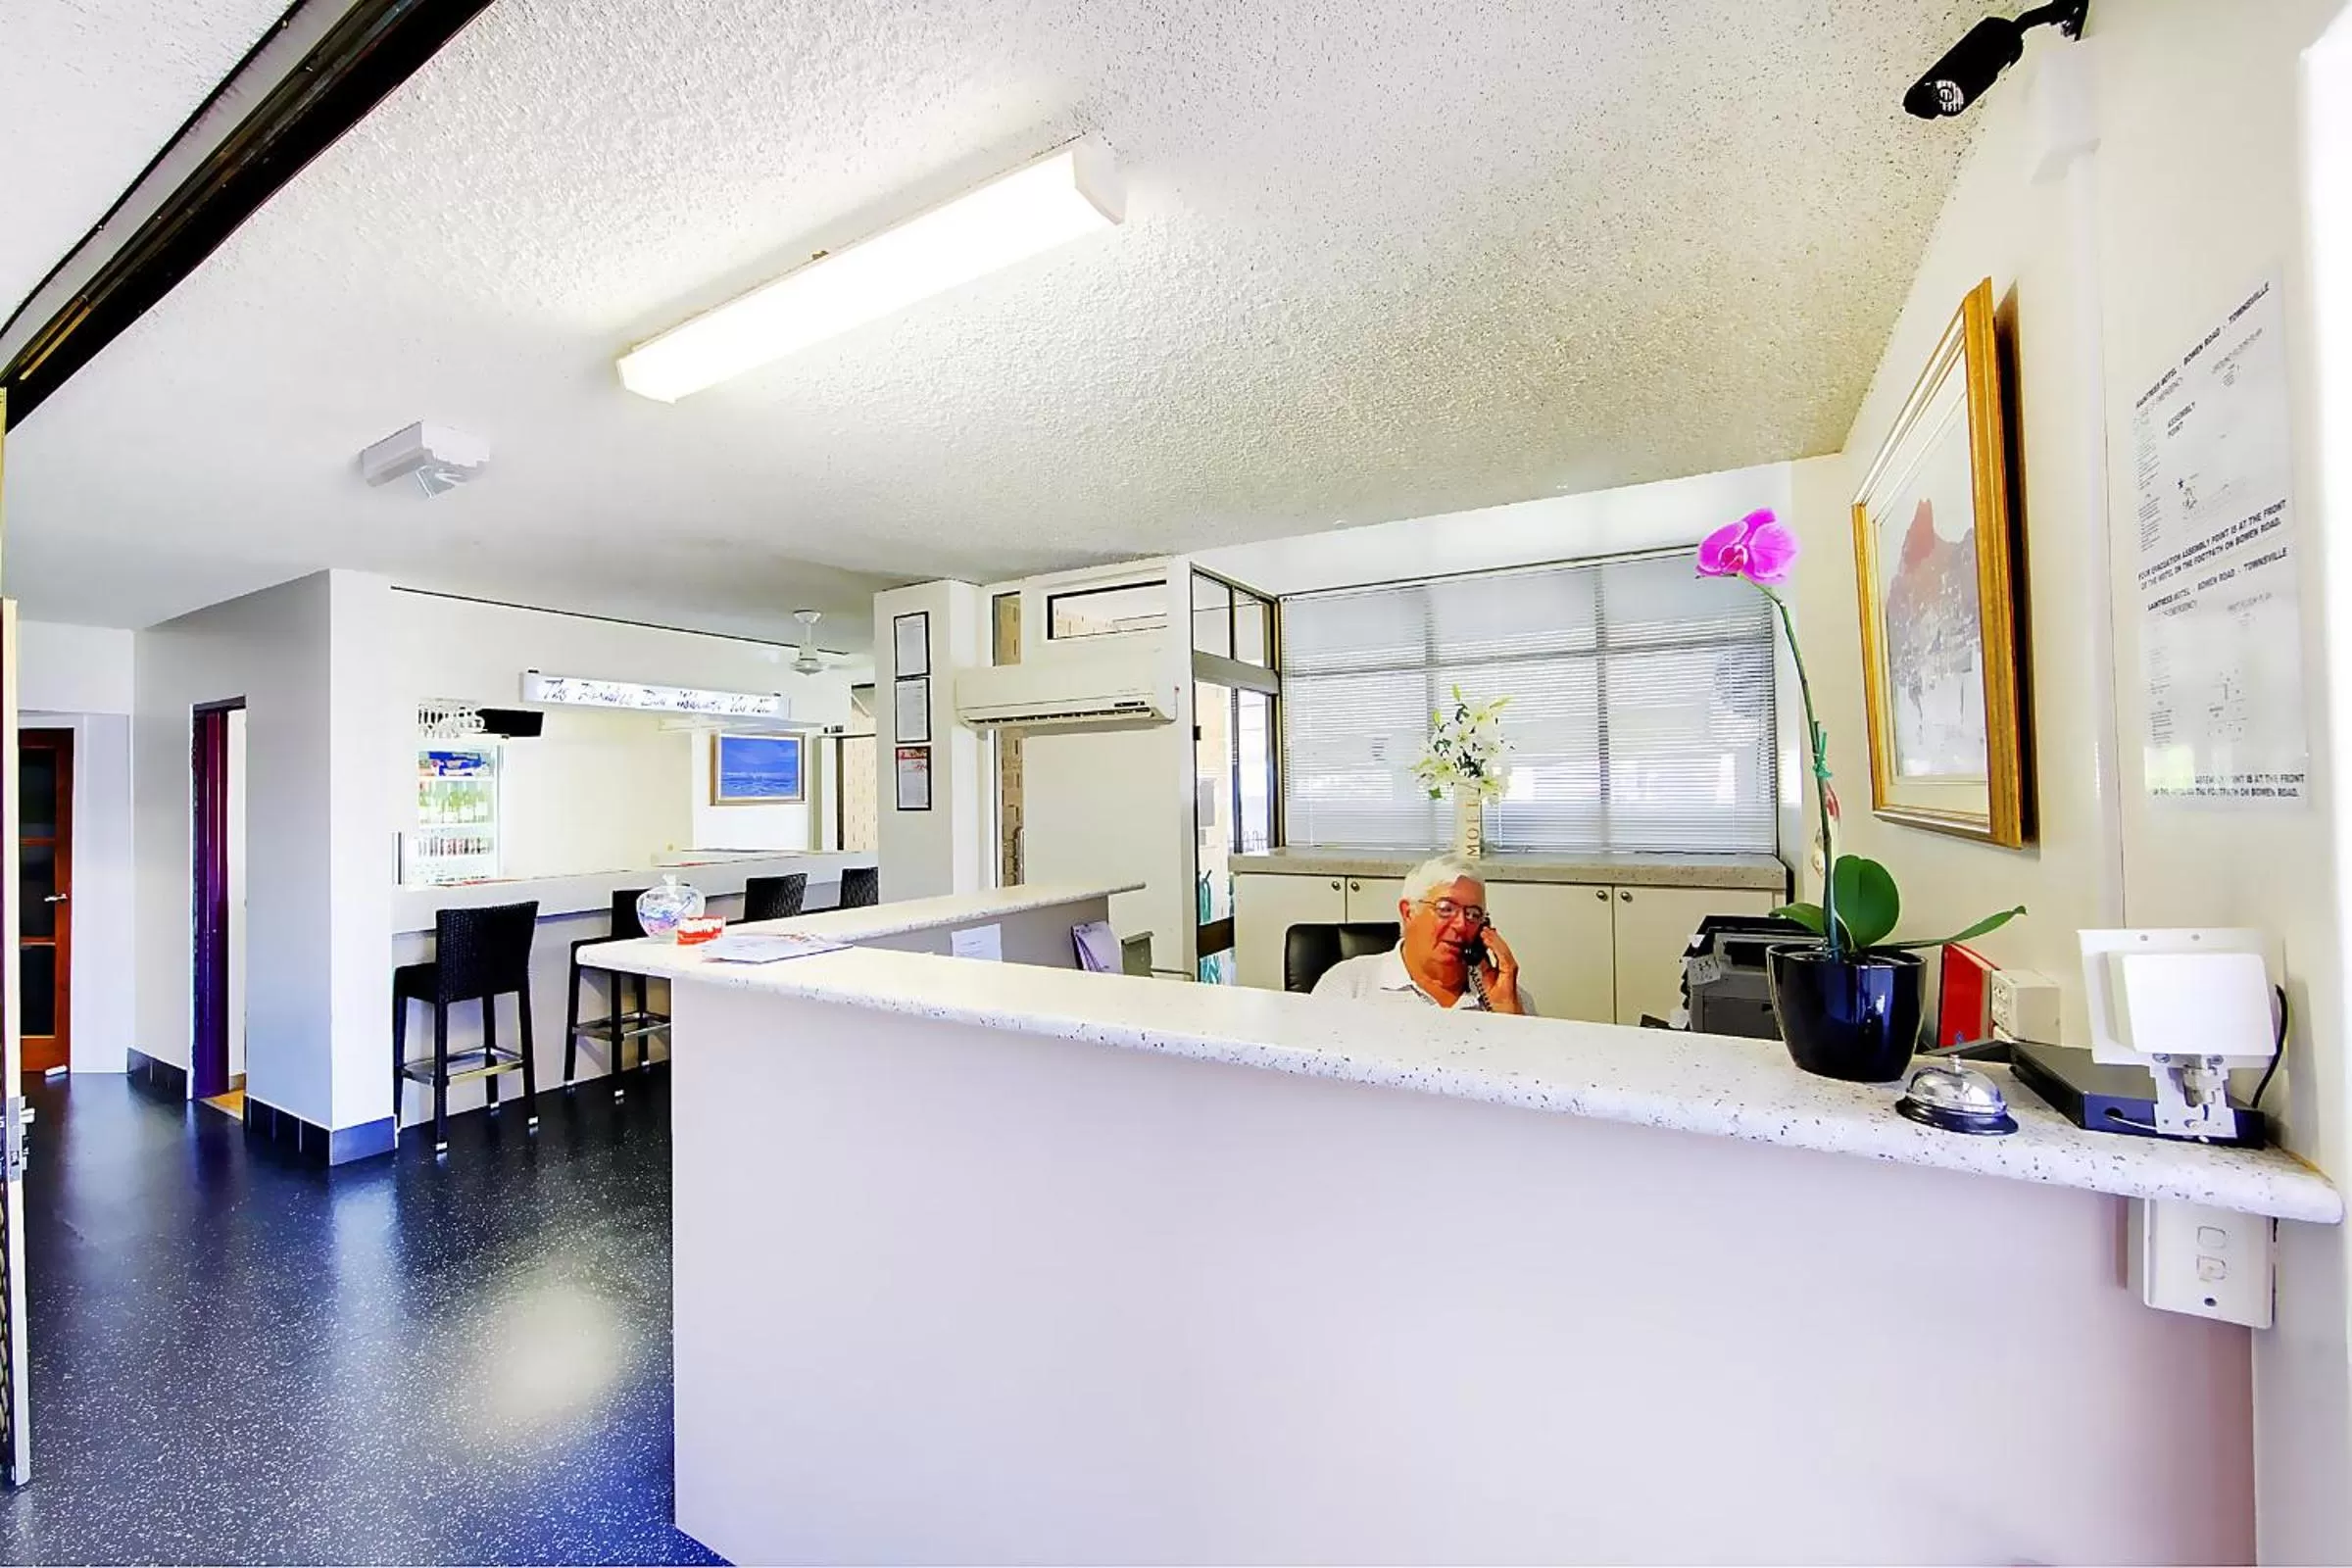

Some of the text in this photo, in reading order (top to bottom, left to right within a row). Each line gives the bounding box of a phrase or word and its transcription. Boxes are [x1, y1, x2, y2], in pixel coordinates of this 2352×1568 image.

[2183, 344, 2203, 366] BOWEN
[2204, 326, 2221, 347] ROAD
[2228, 280, 2270, 324] TOWNSVILLE
[2181, 538, 2210, 558] ASSEMBLY
[2211, 527, 2230, 543] POINT
[2248, 512, 2262, 525] THE
[2263, 499, 2286, 517] FRONT
[2193, 546, 2224, 564] FOOTPATH
[2235, 528, 2258, 546] BOWEN
[2197, 576, 2218, 590] BOWEN
[2219, 568, 2235, 582] ROAD
[2243, 547, 2287, 570] TOWNSVILLE
[2251, 788, 2276, 797] BOWEN
[2280, 773, 2305, 783] FRONT
